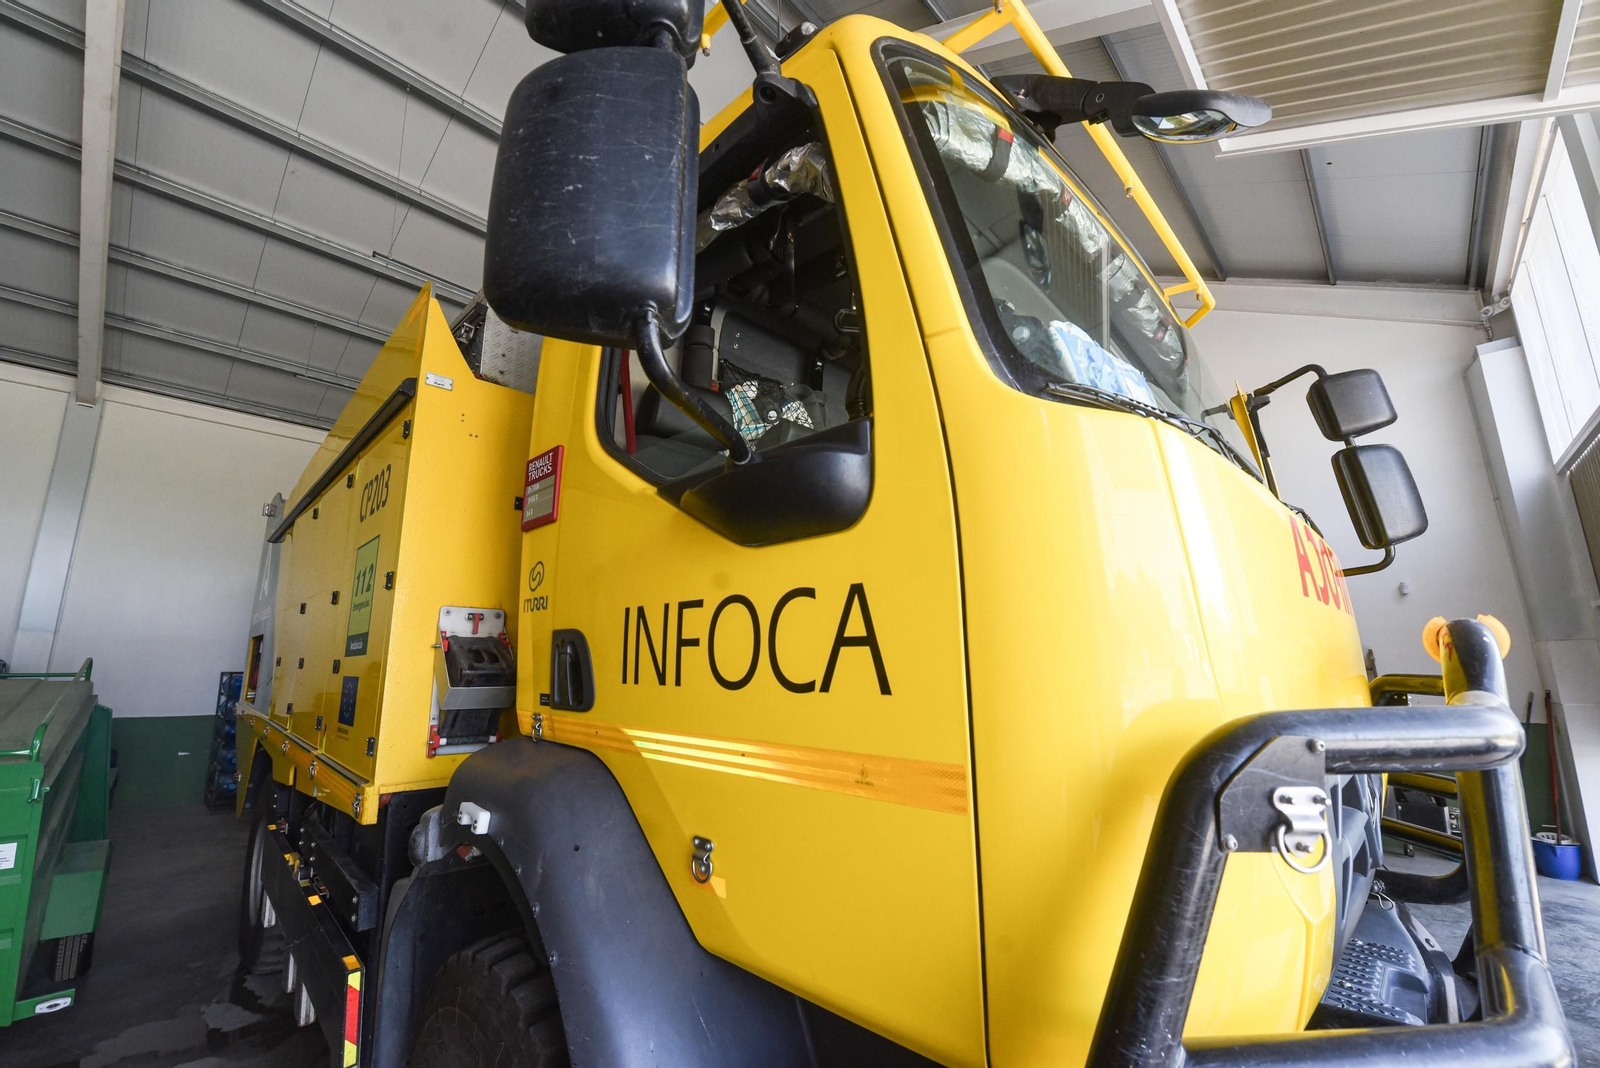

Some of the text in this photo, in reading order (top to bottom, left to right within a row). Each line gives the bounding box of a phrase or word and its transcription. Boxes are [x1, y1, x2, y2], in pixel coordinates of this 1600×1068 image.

[528, 452, 554, 473] RENAULT
[528, 462, 552, 482] TRUCKS
[360, 463, 392, 523] CP203
[355, 563, 375, 597] 112
[523, 595, 549, 613] ITURRI
[621, 582, 893, 696] INFOCA
